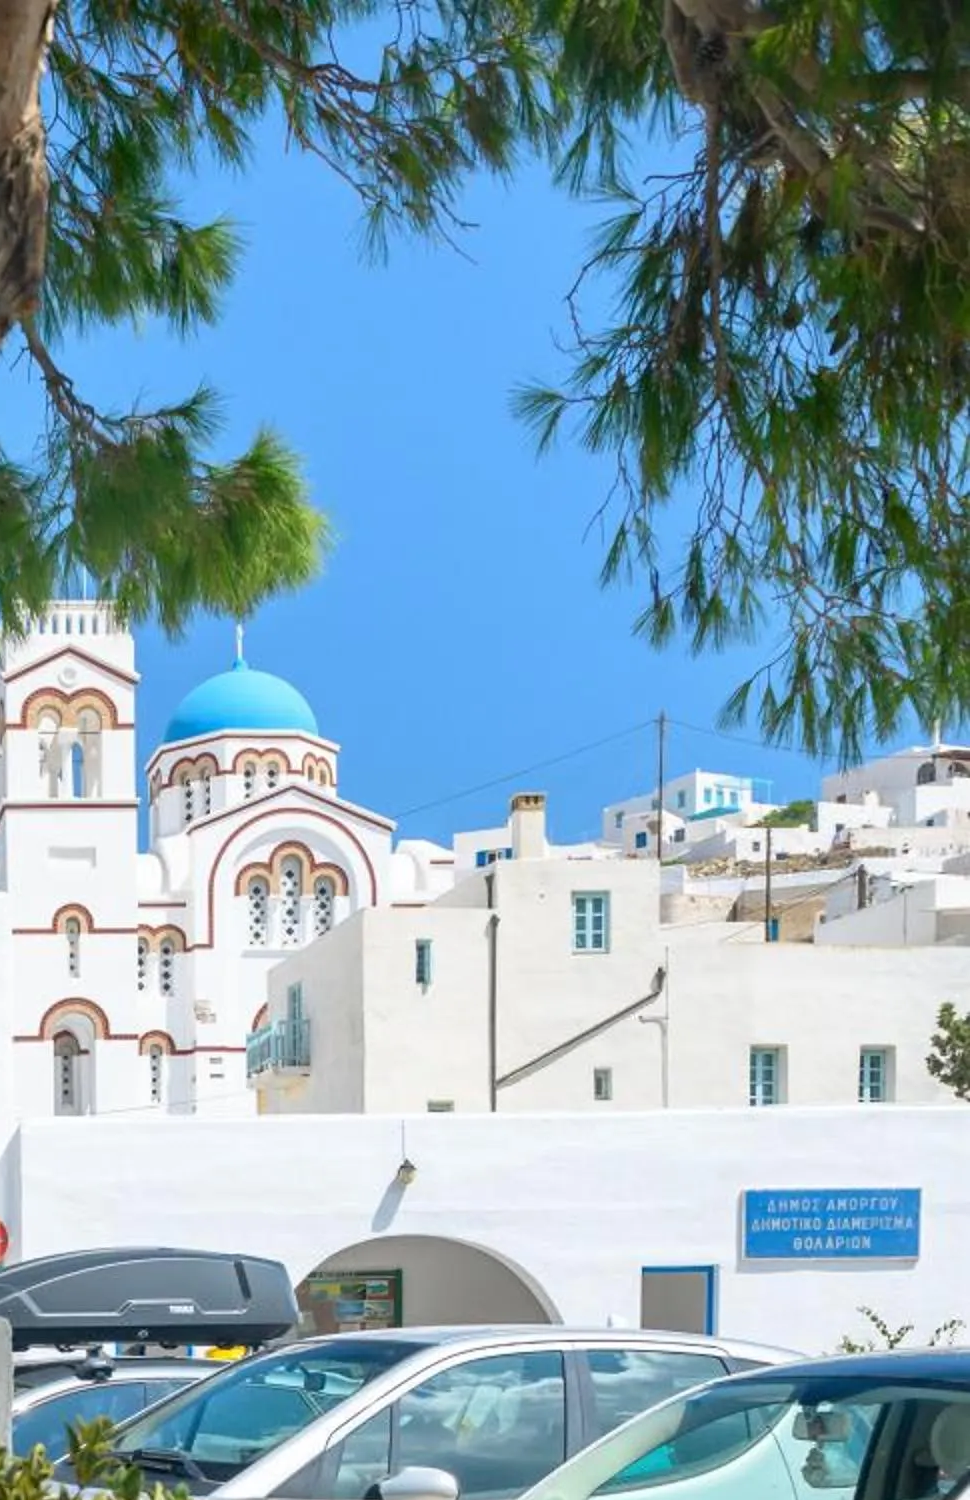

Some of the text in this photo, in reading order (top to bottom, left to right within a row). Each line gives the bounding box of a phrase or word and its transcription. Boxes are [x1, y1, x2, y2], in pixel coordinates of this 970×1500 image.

[767, 1198, 898, 1213] ΔΗΜΟΣ ΑΜΟΡΓΟΥ
[752, 1216, 914, 1232] ΔΗΜΟΤΙΚΟ ΔΙΑΜΕΡΙΣΜΑ
